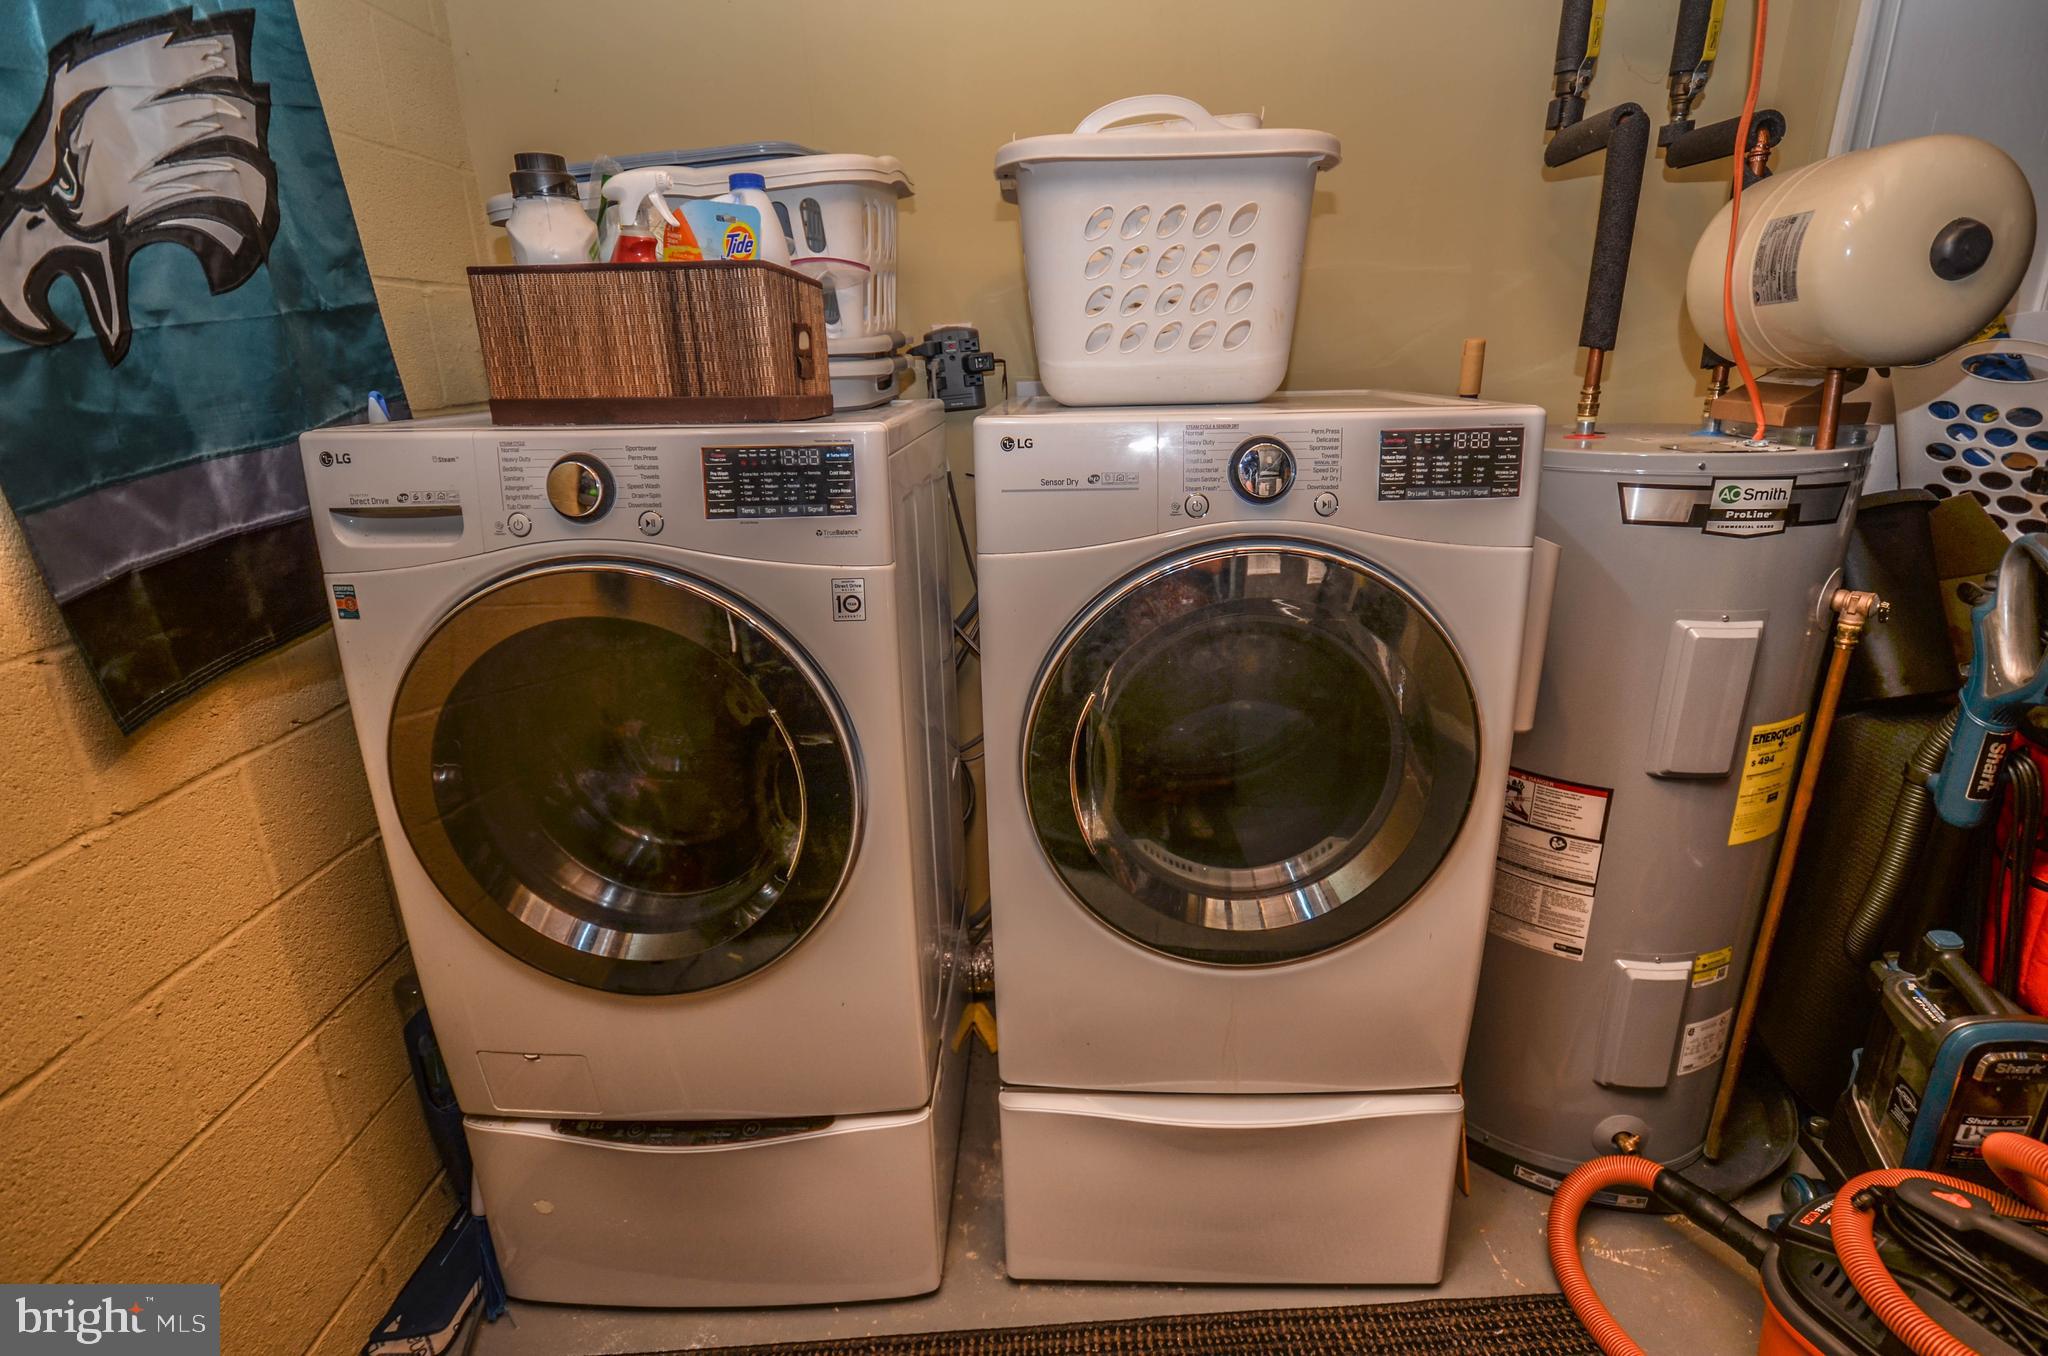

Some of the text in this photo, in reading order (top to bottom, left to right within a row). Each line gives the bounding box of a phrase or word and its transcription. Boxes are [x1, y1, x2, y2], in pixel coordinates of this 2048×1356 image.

[726, 231, 755, 258] Tide
[1017, 438, 1034, 449] LG
[336, 453, 352, 464] LG
[1040, 477, 1079, 488] Sensor Dry
[350, 497, 390, 505] Direct Drive
[1725, 510, 1770, 519] ProLine
[1757, 754, 1775, 766] 494
[1977, 742, 2007, 793] Shark
[1995, 1062, 2042, 1074] Shark
[1965, 1116, 1999, 1126] Shark
